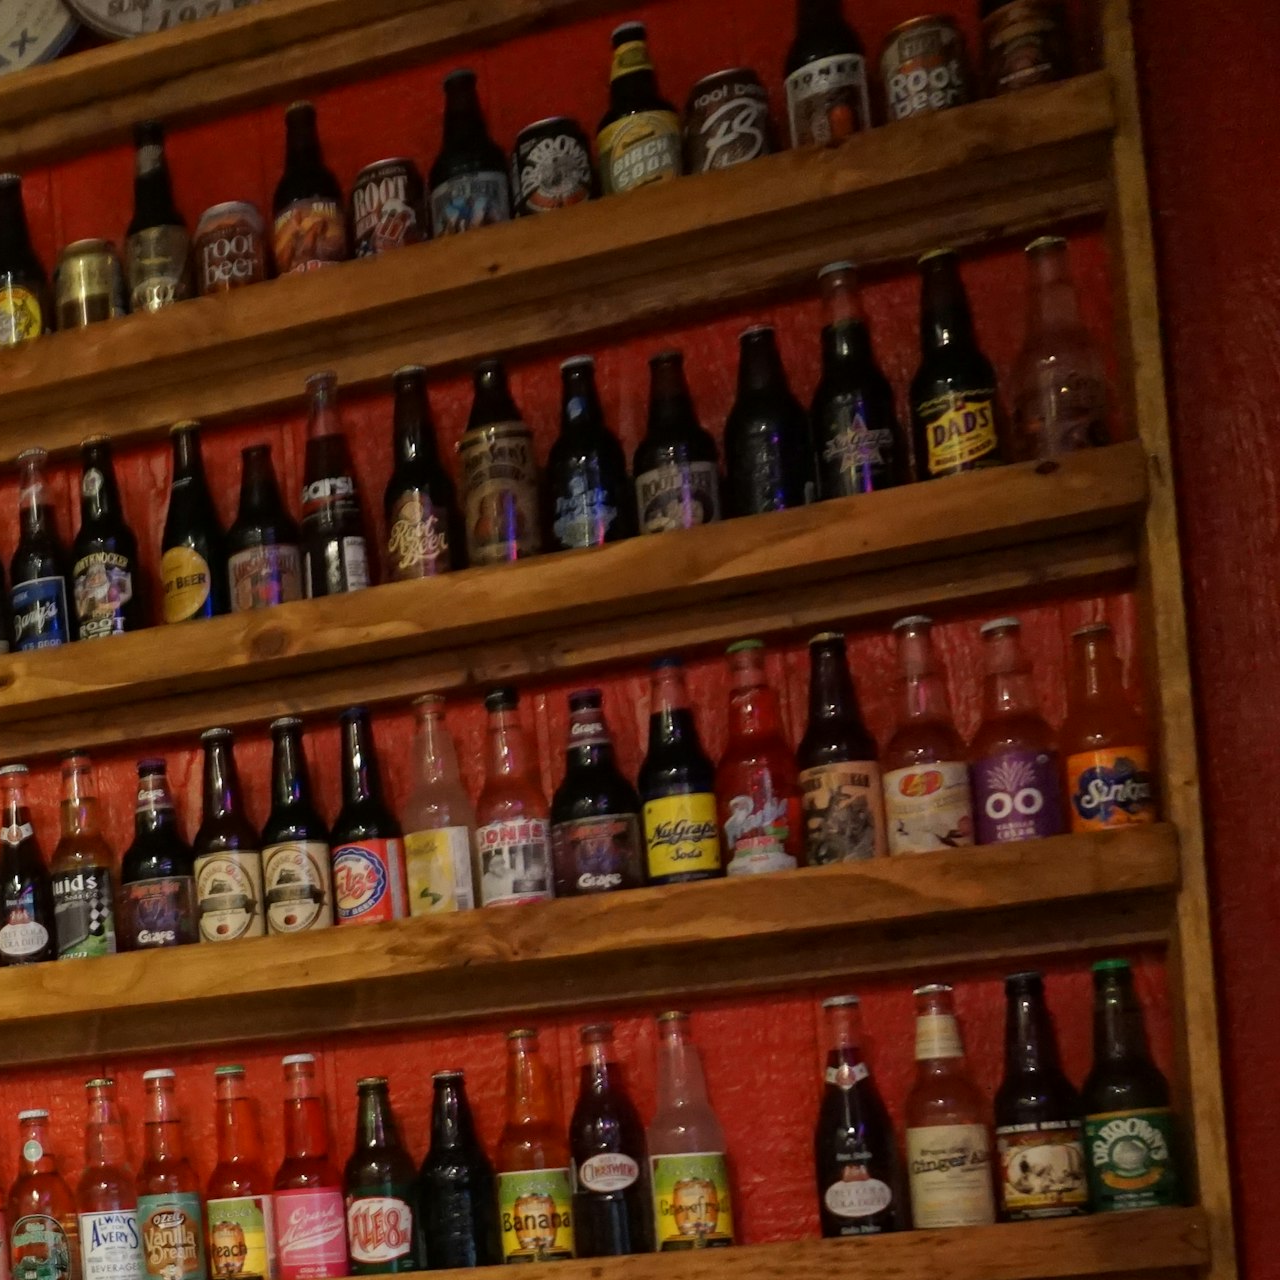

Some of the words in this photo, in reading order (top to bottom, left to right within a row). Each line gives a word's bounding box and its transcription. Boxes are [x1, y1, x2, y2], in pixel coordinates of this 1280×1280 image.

[611, 138, 669, 176] BIRCH
[613, 152, 676, 192] SODA
[203, 240, 256, 260] root
[204, 258, 258, 286] beer
[930, 407, 994, 443] DAD'S
[503, 1212, 573, 1233] Banana
[144, 1228, 195, 1248] Vanilla
[153, 1243, 197, 1262] Dream
